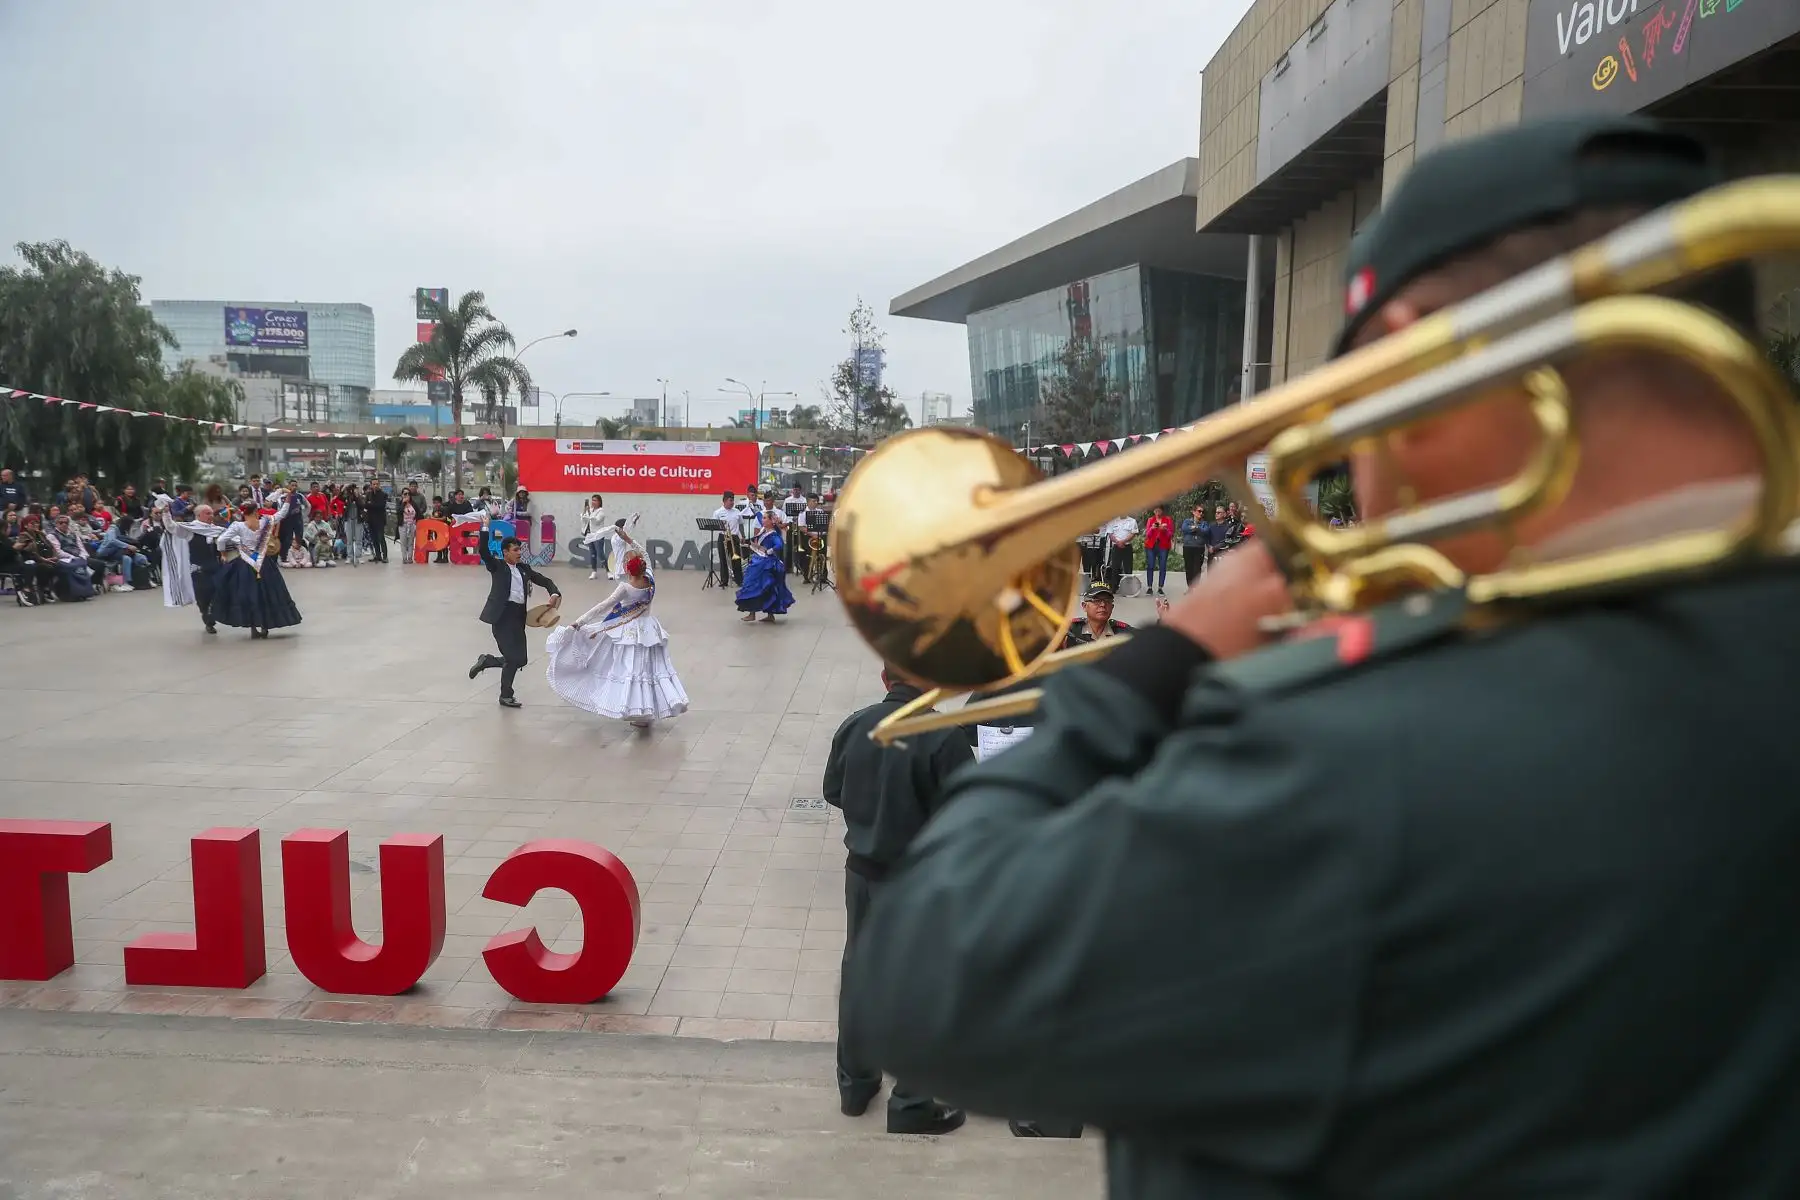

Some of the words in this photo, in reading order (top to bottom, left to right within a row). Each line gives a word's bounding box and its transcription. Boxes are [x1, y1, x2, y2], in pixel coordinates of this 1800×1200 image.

[563, 464, 635, 477] Ministerio
[638, 464, 656, 477] de
[660, 465, 712, 478] Cultura
